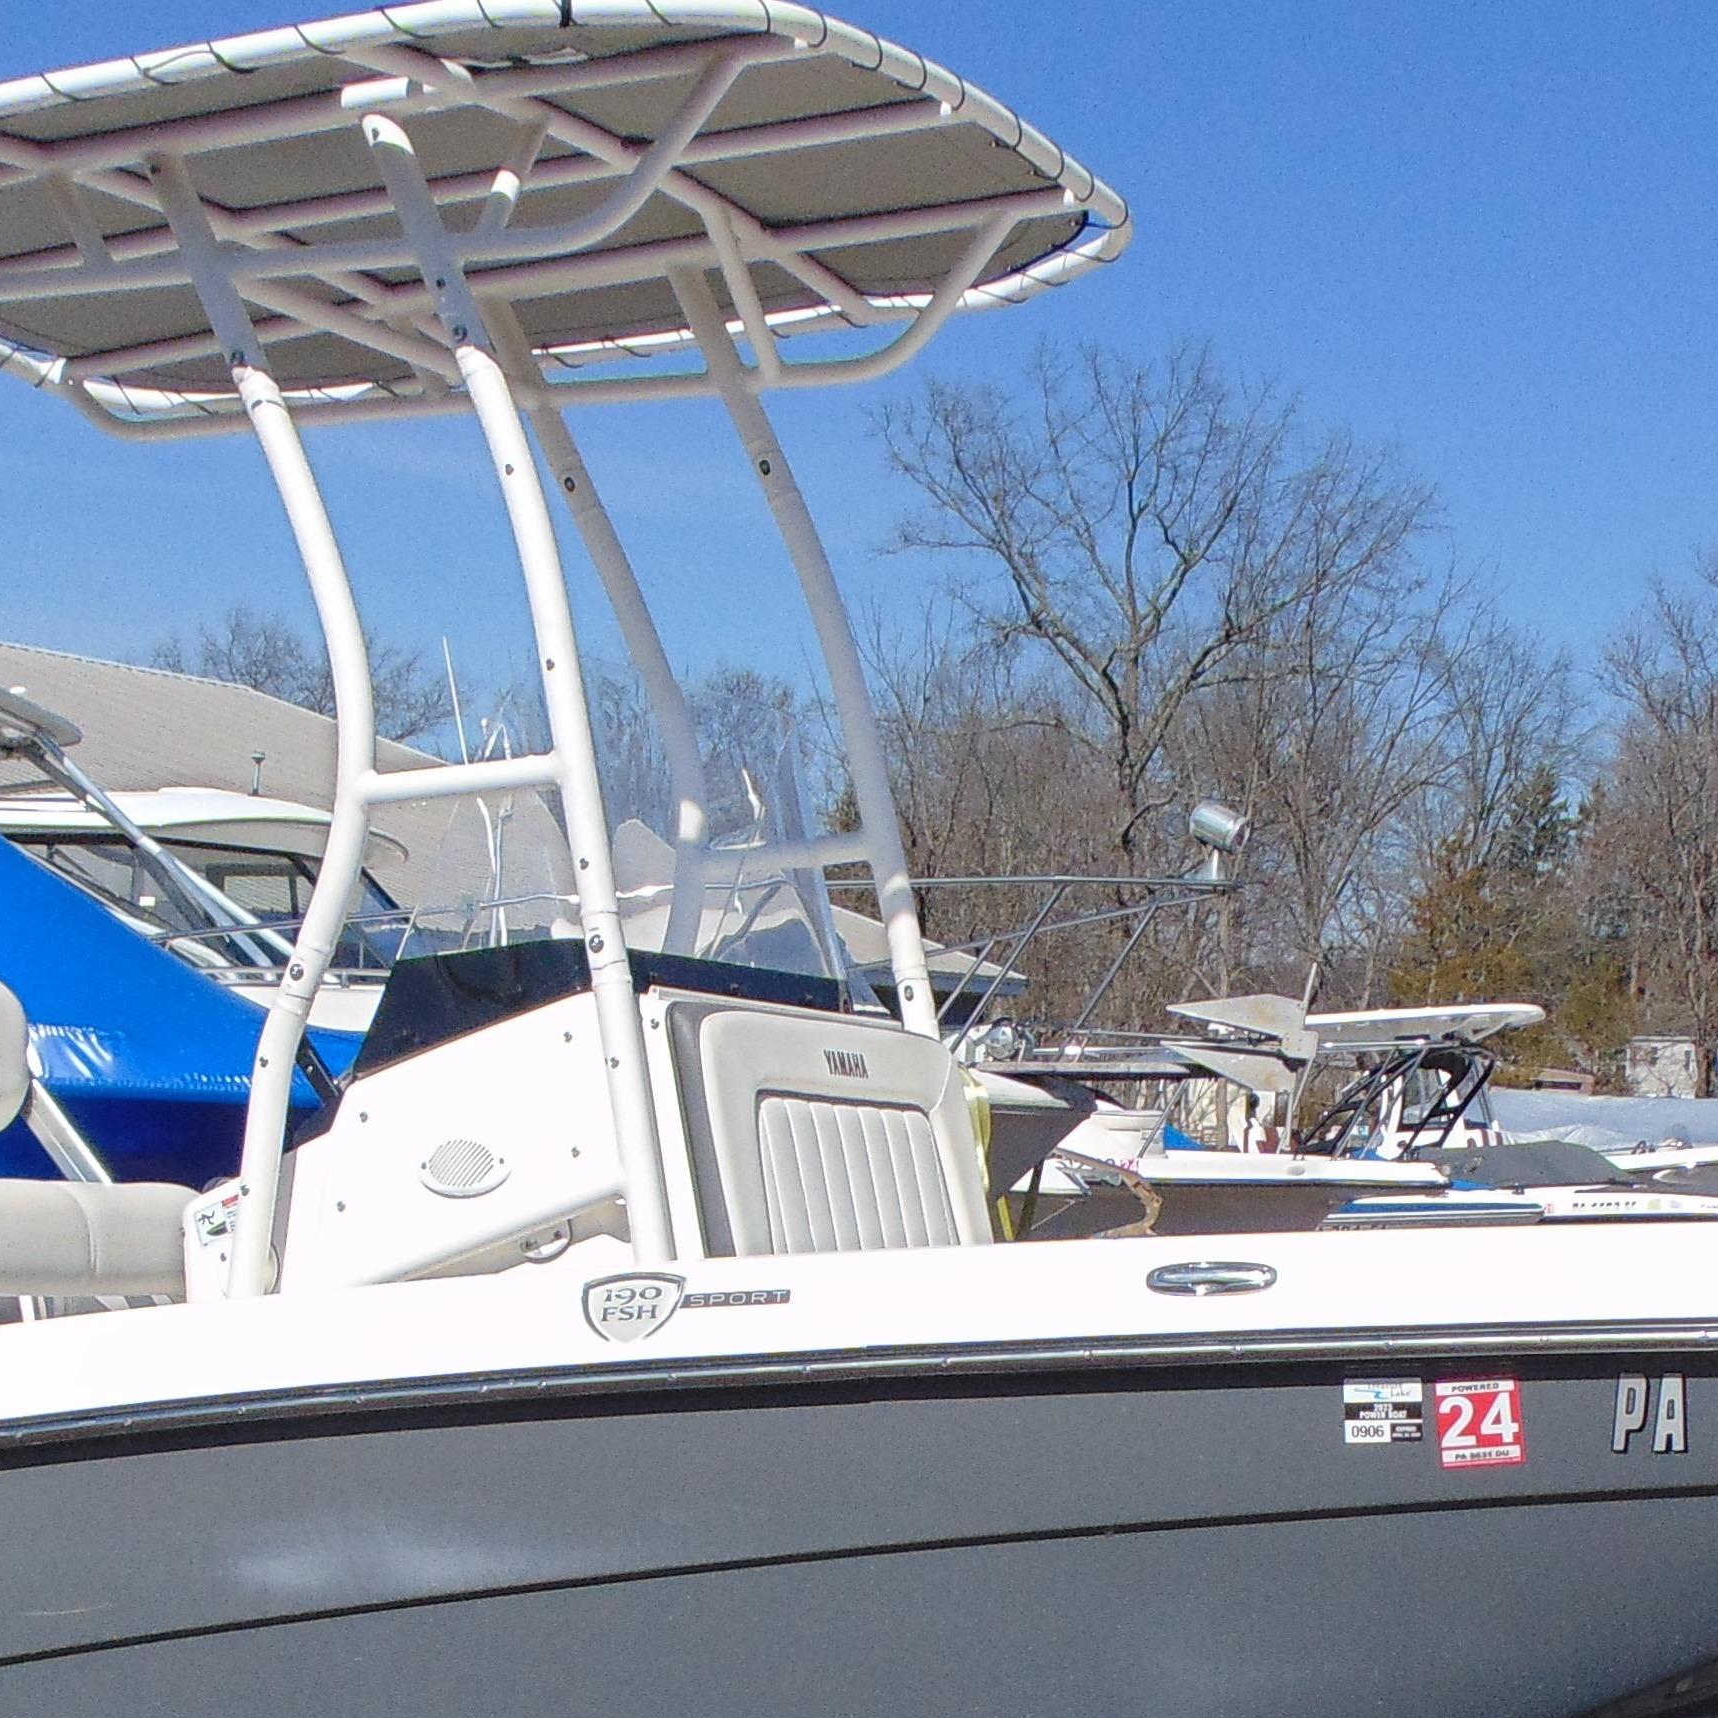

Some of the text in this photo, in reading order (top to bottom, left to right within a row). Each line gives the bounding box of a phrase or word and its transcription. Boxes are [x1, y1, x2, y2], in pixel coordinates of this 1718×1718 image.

[823, 1049, 869, 1079] YAMAHA
[604, 1286, 663, 1306] 190
[689, 1290, 788, 1307] SPORT
[601, 1304, 658, 1322] FSH
[1451, 1382, 1500, 1393] POWERED
[1439, 1392, 1519, 1448] 24
[1611, 1371, 1688, 1453] PA
[1351, 1424, 1385, 1438] 0906
